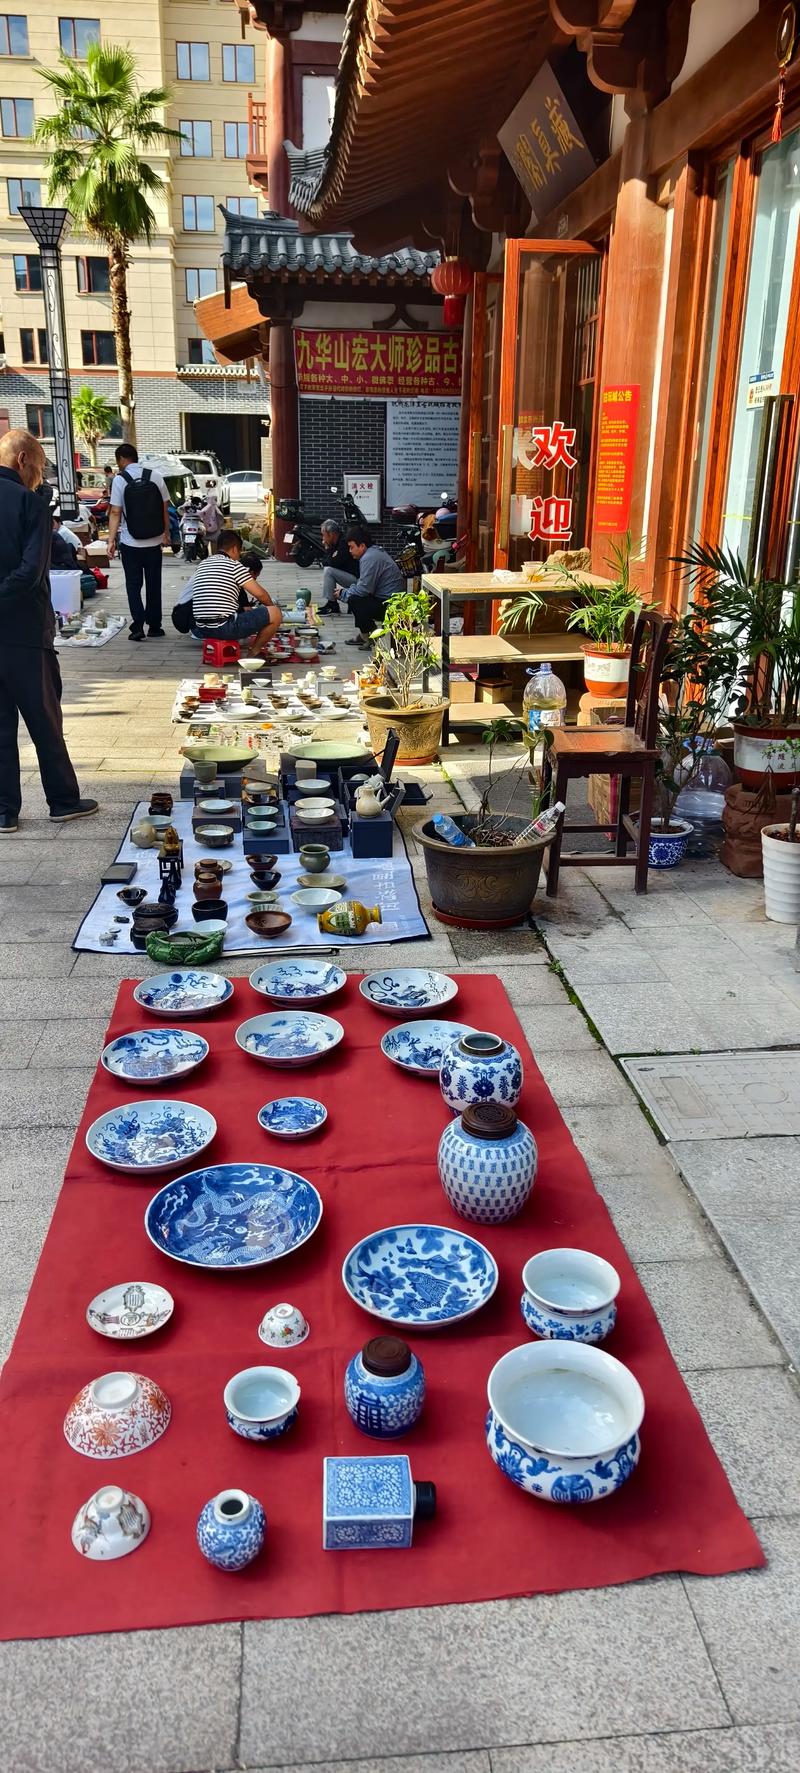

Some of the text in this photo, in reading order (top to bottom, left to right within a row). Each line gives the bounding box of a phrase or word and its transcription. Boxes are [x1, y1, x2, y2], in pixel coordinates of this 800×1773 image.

[297, 332, 460, 374] 九华山宏大师珍品古
[398, 376, 463, 387] 经营各种古、今、
[530, 422, 577, 541] 欢迎
